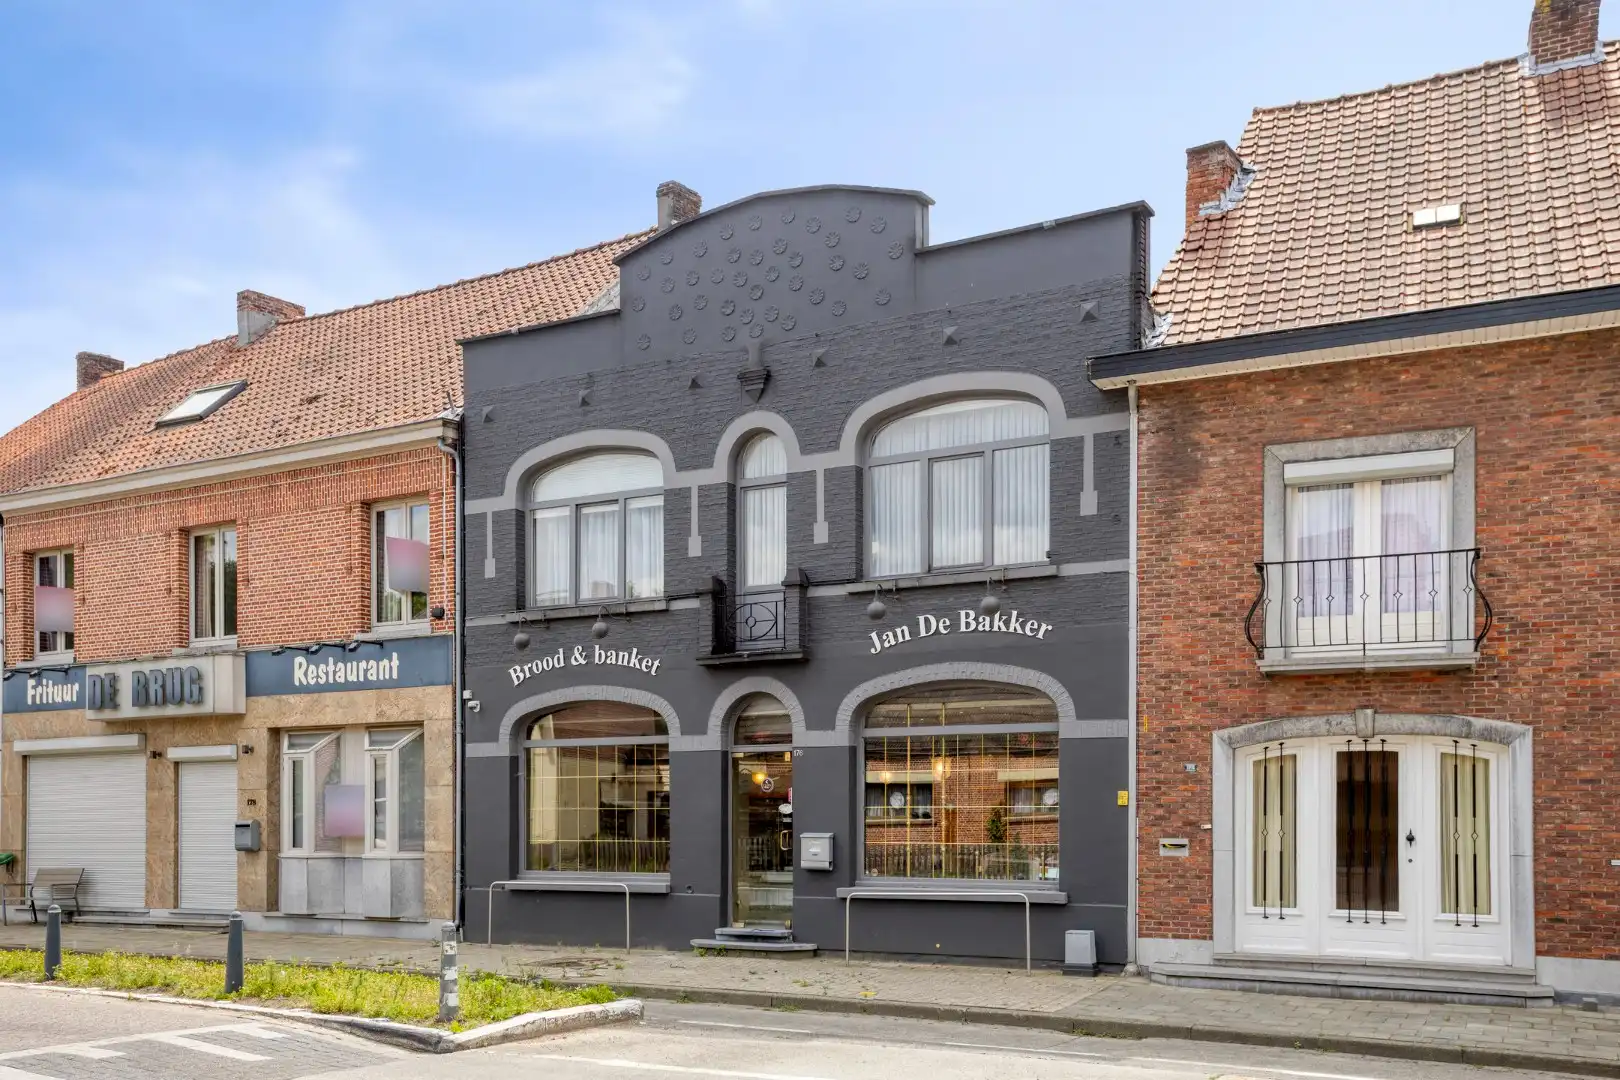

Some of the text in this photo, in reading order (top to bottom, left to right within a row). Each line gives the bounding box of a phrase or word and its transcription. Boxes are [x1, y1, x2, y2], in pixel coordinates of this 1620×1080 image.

[868, 609, 1053, 654] Jan De Bakker
[293, 652, 399, 686] Restaurant
[507, 645, 661, 687] Brood & banket
[27, 679, 79, 705] Frituur
[88, 665, 204, 711] DE BRUG
[793, 749, 804, 757] 176
